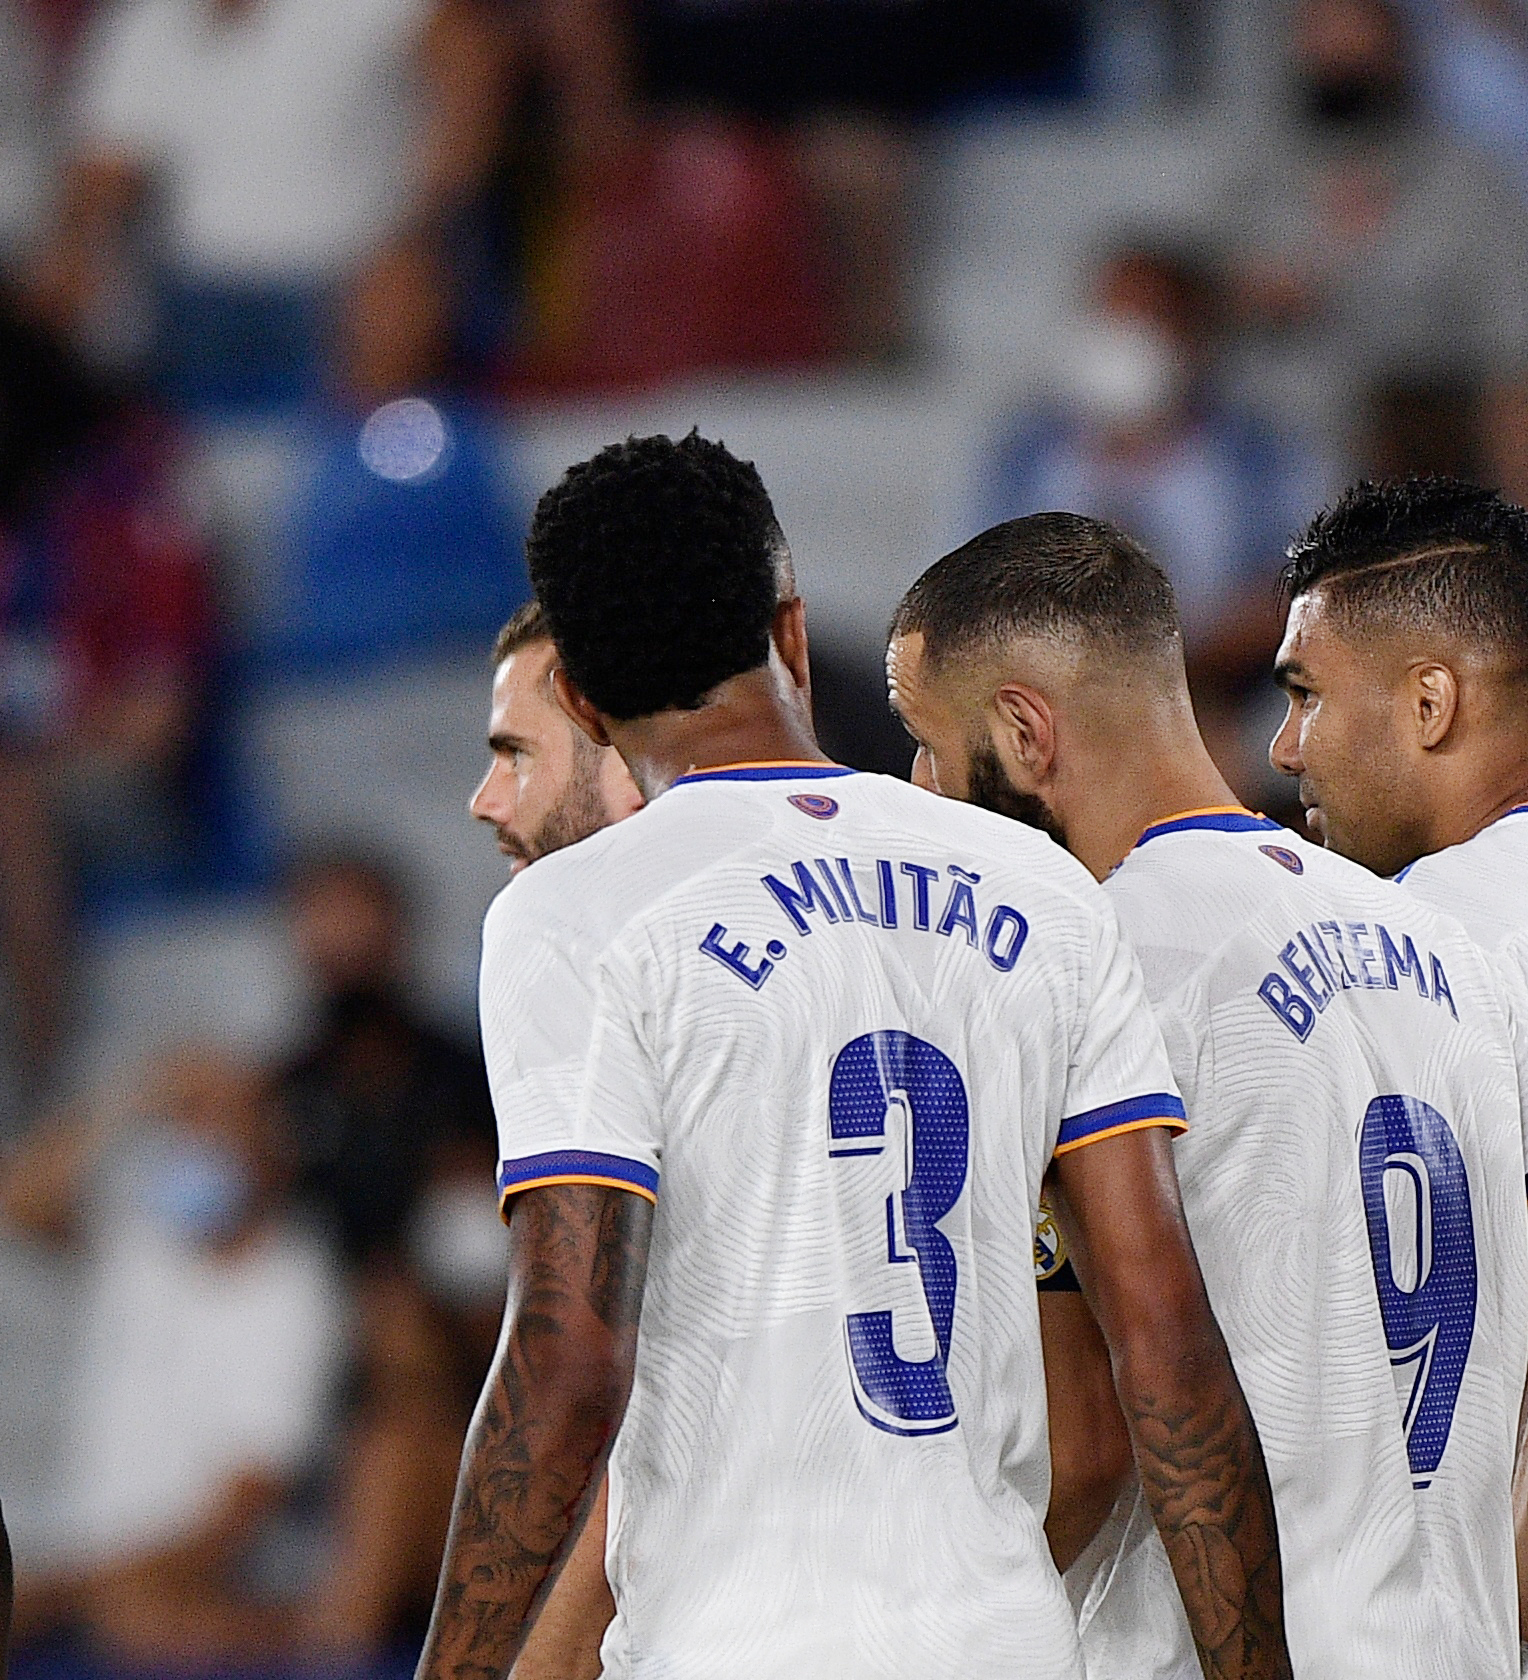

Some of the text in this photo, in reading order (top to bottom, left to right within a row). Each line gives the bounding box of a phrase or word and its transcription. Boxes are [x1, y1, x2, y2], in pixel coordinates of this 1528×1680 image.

[700, 857, 1030, 991] E. MILITÃO
[1258, 920, 1459, 1043] BENZEMA
[829, 1029, 970, 1437] 3
[1356, 1094, 1477, 1489] 9
